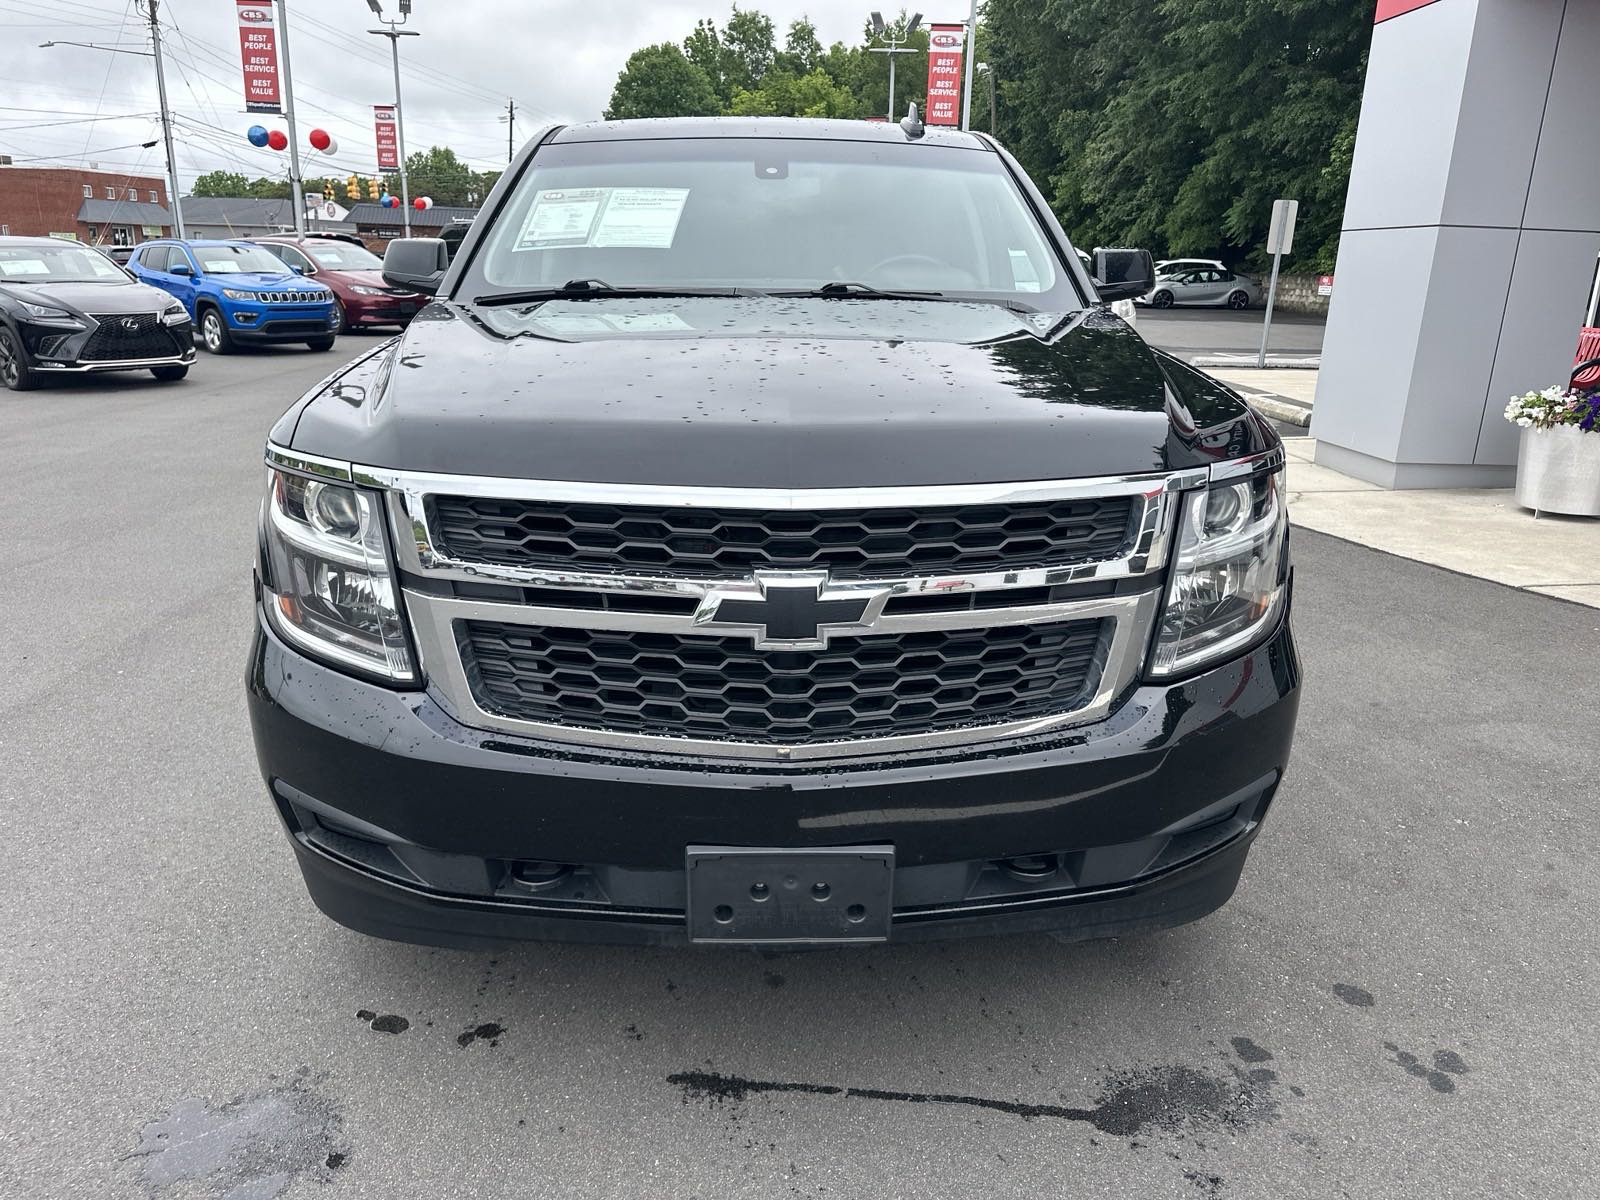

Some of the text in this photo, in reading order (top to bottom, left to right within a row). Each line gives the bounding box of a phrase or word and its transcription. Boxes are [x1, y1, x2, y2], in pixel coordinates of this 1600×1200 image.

[248, 34, 268, 42] BEST
[244, 42, 272, 50] PEOPLE
[244, 65, 275, 73] SERVICE
[250, 87, 274, 95] VALUE
[932, 110, 953, 118] VALUE
